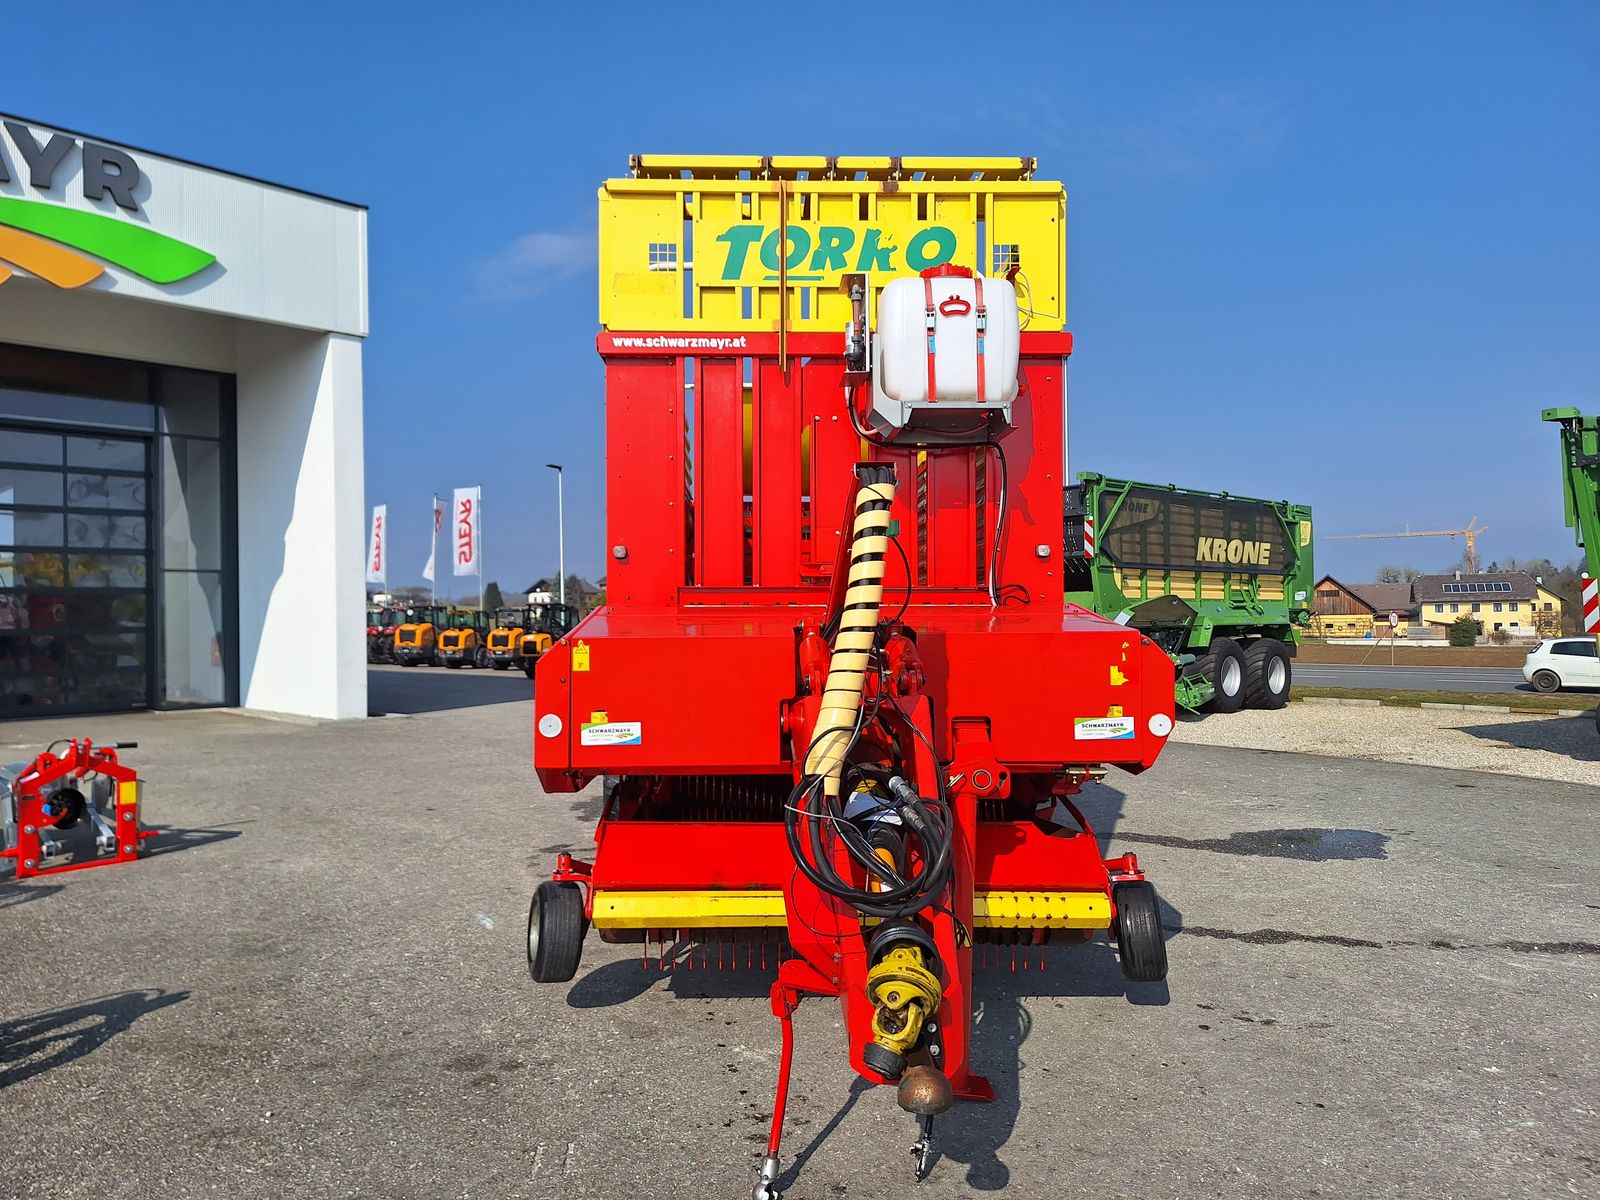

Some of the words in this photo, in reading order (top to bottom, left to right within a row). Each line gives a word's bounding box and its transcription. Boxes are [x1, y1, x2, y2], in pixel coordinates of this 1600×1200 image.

[0, 120, 139, 212] YR
[716, 225, 957, 281] TORKO
[612, 335, 746, 350] www.schwarzmayr.at
[1196, 536, 1271, 565] KRONE
